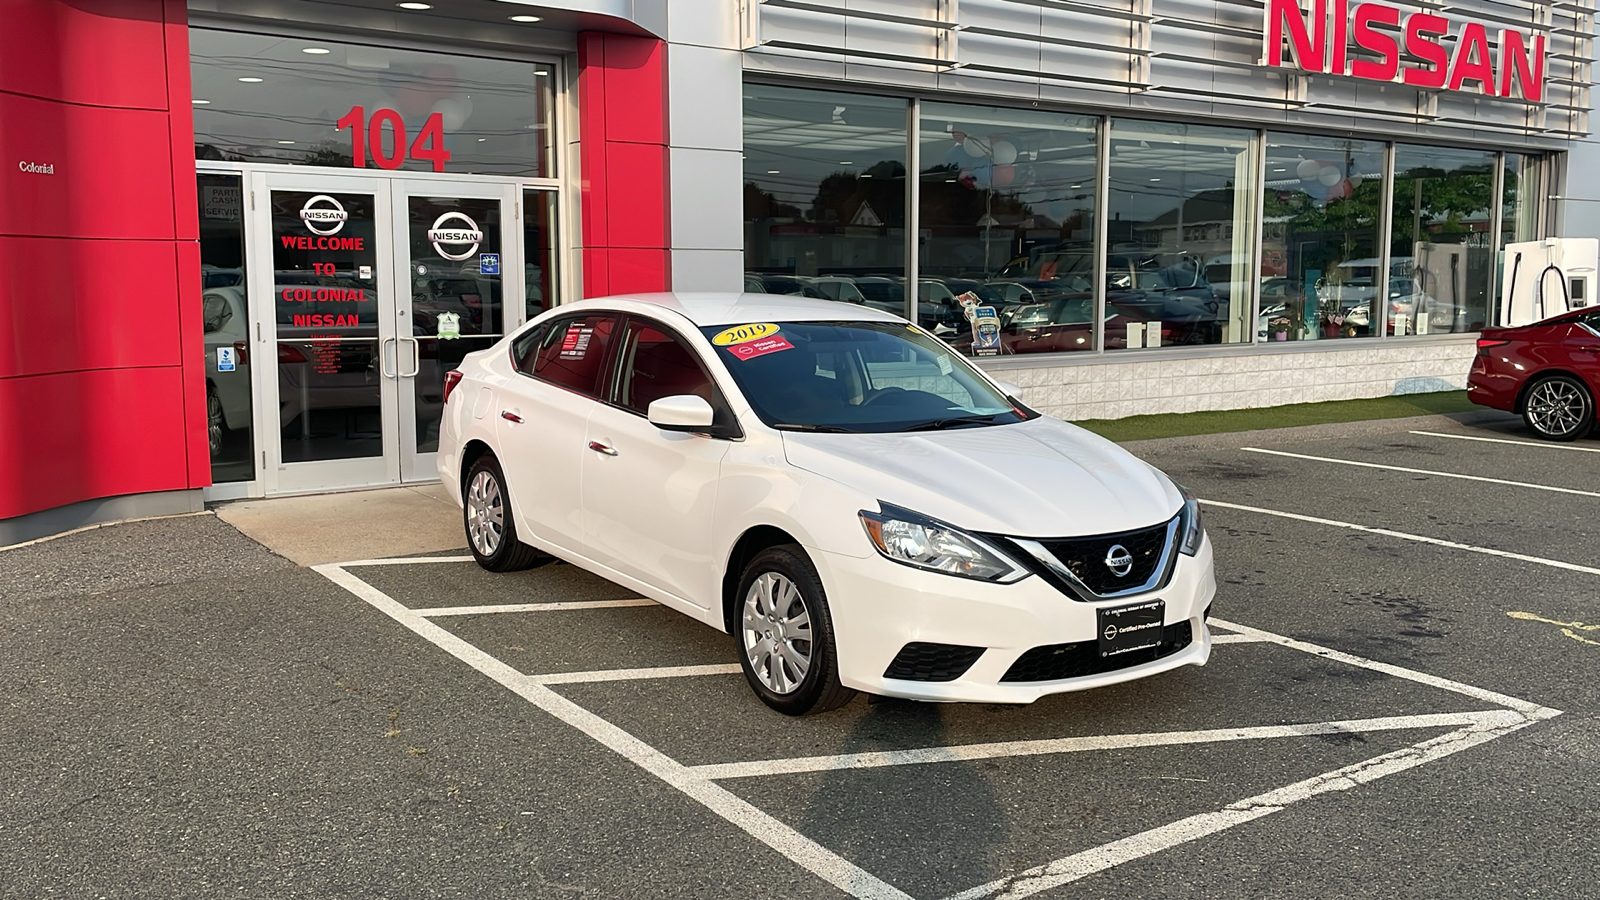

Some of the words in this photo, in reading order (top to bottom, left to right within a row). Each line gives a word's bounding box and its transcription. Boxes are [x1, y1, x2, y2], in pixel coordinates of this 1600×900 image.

[1263, 0, 1546, 102] NISSAN
[337, 106, 451, 173] 104
[19, 161, 54, 174] Colonial
[304, 211, 344, 219] NISSAN
[433, 232, 478, 241] NISSAN
[281, 236, 364, 251] WELCOME
[312, 262, 336, 276] TO
[282, 287, 368, 302] COLONIAL
[293, 314, 359, 327] NISSAN
[726, 324, 766, 342] 2019
[753, 340, 776, 348] Nissan
[758, 342, 786, 351] Certified
[1110, 556, 1131, 565] NISSAN
[1138, 621, 1161, 630] Pre-Owned
